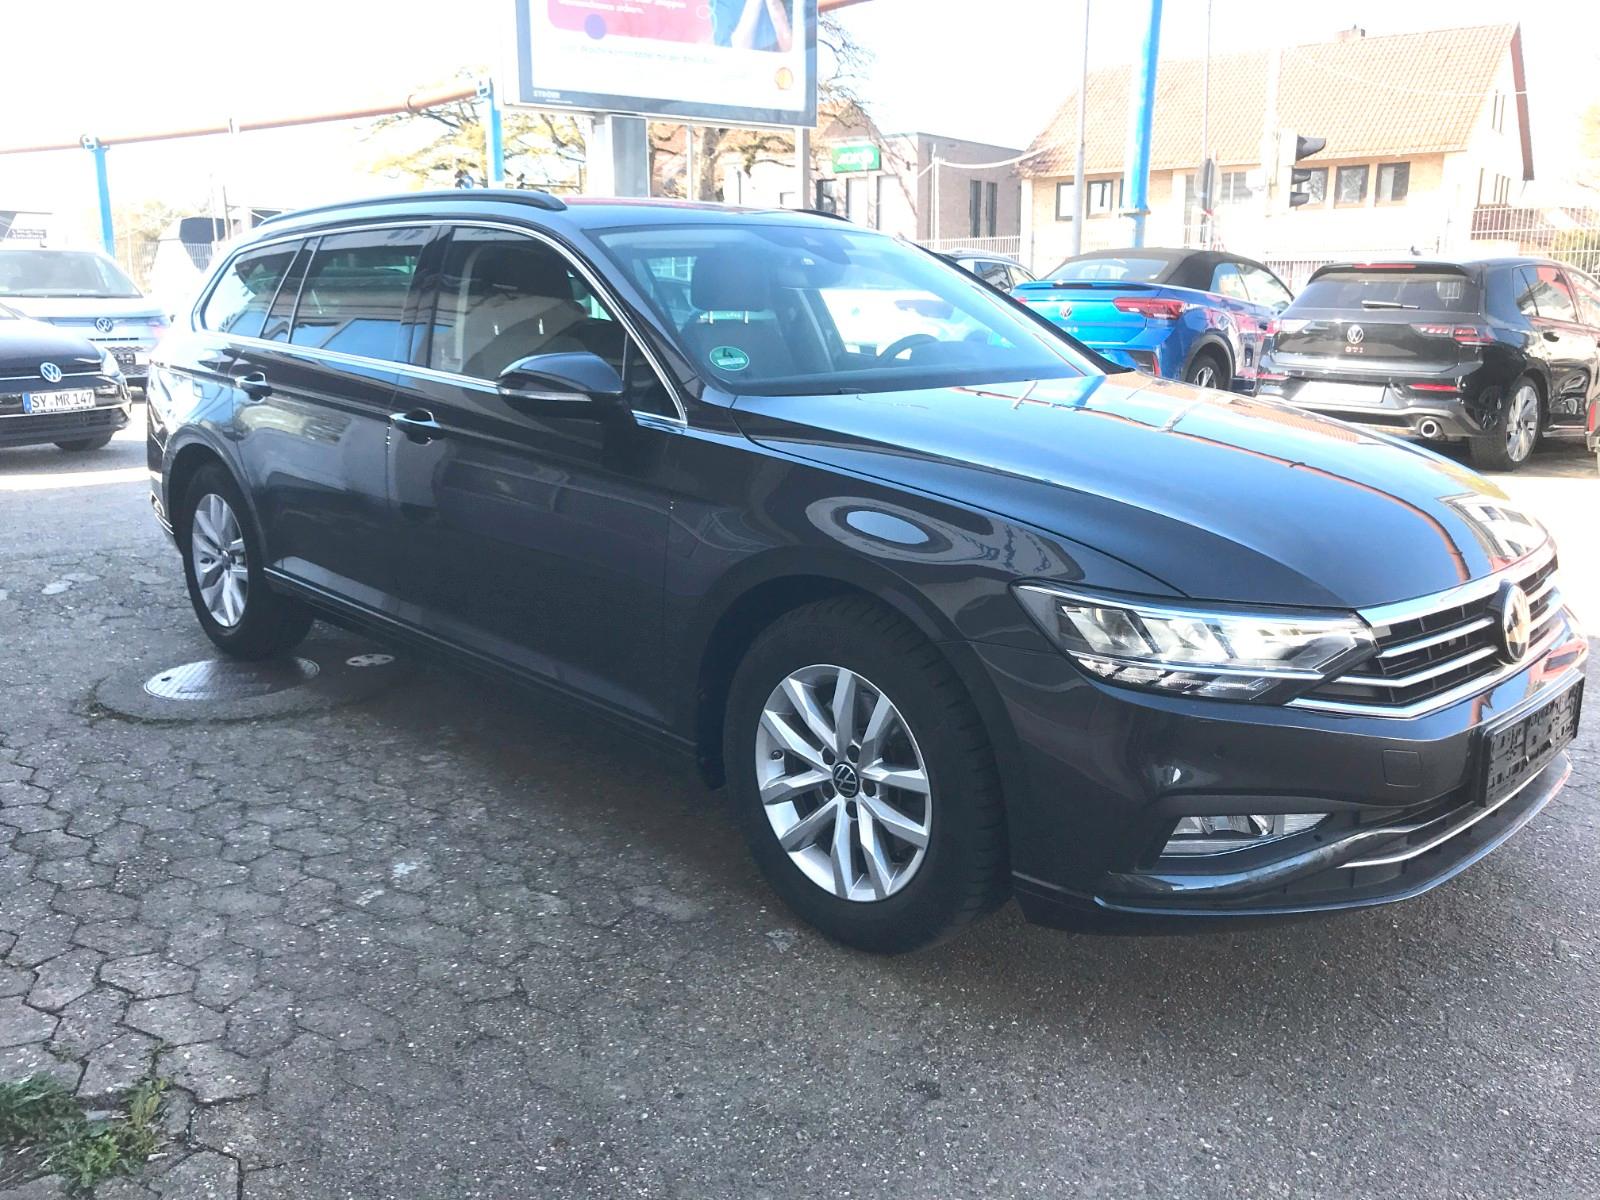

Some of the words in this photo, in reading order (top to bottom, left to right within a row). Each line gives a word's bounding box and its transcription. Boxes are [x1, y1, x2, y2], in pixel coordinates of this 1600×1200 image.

[32, 395, 47, 408] SY
[55, 394, 71, 407] MR
[73, 392, 93, 405] 147
